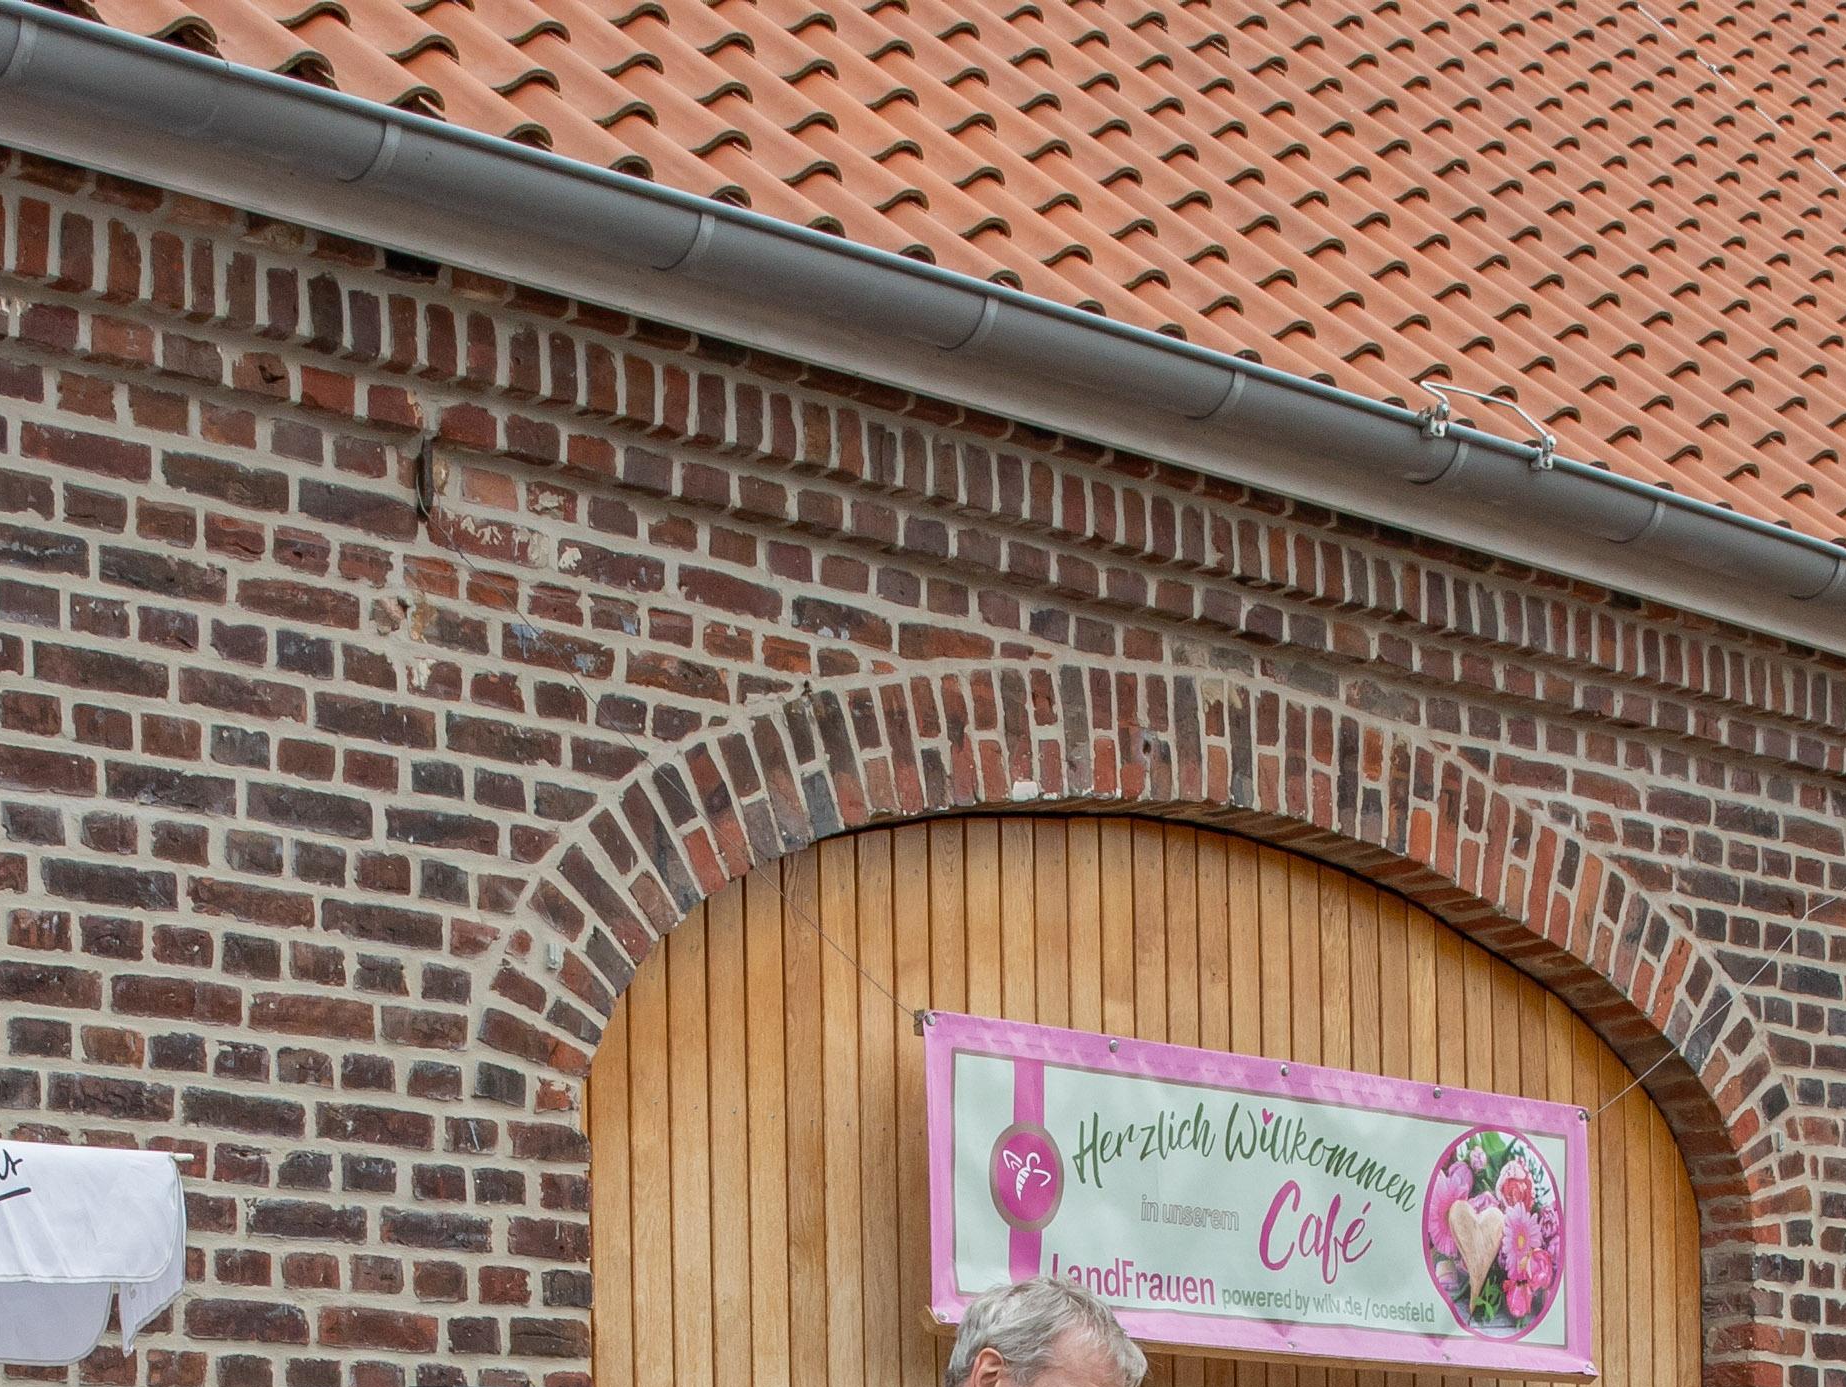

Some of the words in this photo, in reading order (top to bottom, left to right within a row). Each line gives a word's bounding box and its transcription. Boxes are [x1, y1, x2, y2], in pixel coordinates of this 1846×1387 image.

[1072, 1102, 1216, 1189] Herzlich
[1225, 1102, 1416, 1213] Willkommen
[1140, 1194, 1159, 1223] in
[1162, 1199, 1240, 1232] unserem
[1259, 1180, 1373, 1285] Café
[1051, 1252, 1216, 1306] LandFrauen
[1222, 1288, 1292, 1311] powered
[1294, 1290, 1310, 1316] by
